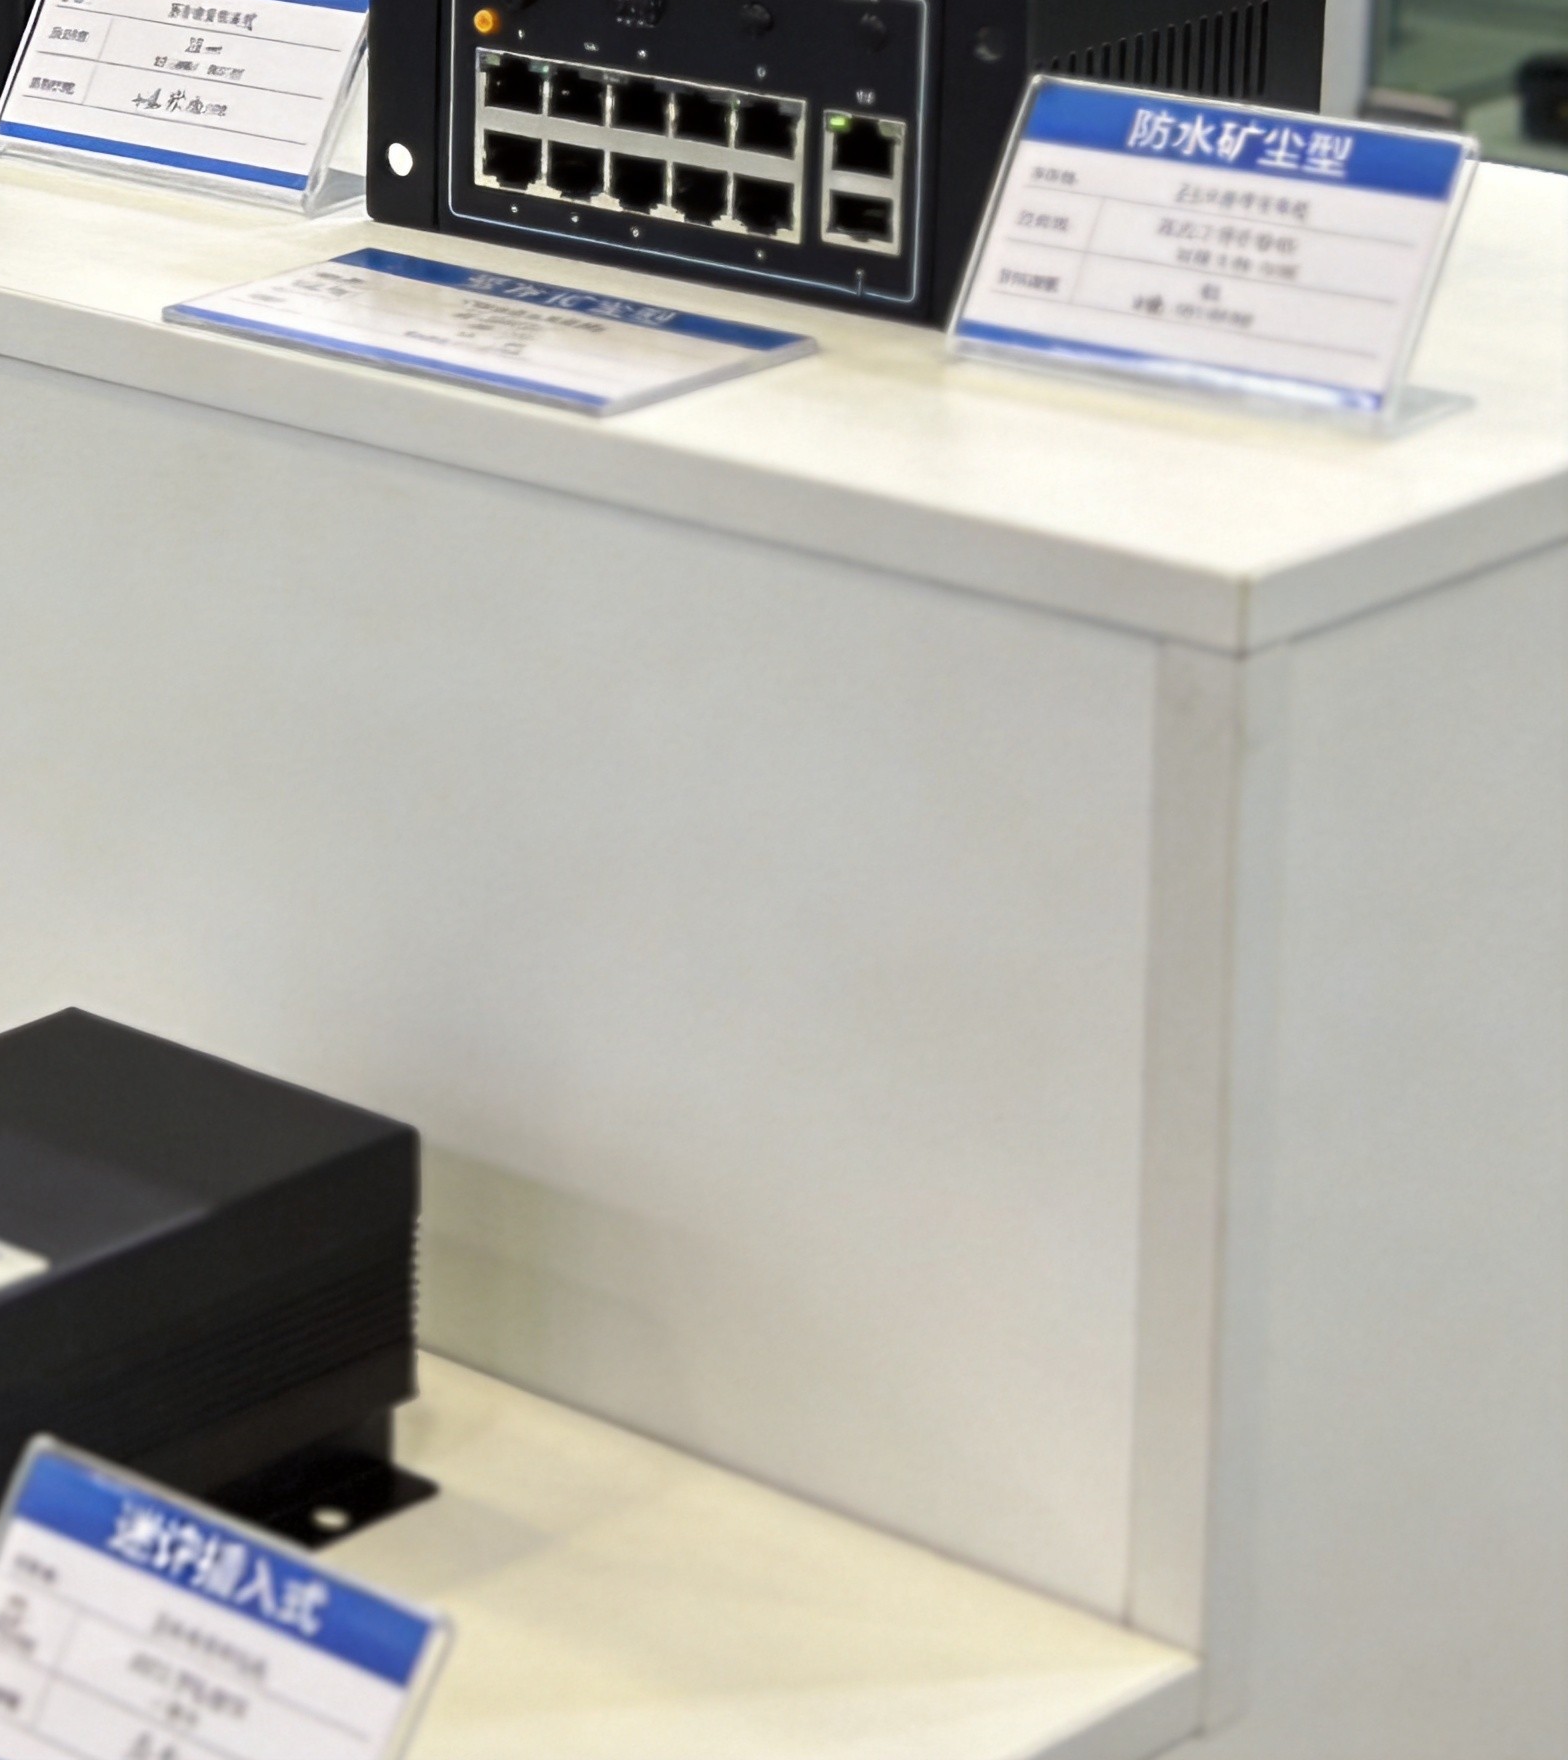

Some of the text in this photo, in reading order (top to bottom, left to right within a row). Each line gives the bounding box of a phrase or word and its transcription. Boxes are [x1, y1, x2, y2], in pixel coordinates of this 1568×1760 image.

[1125, 108, 1354, 177] 防水矿尘型
